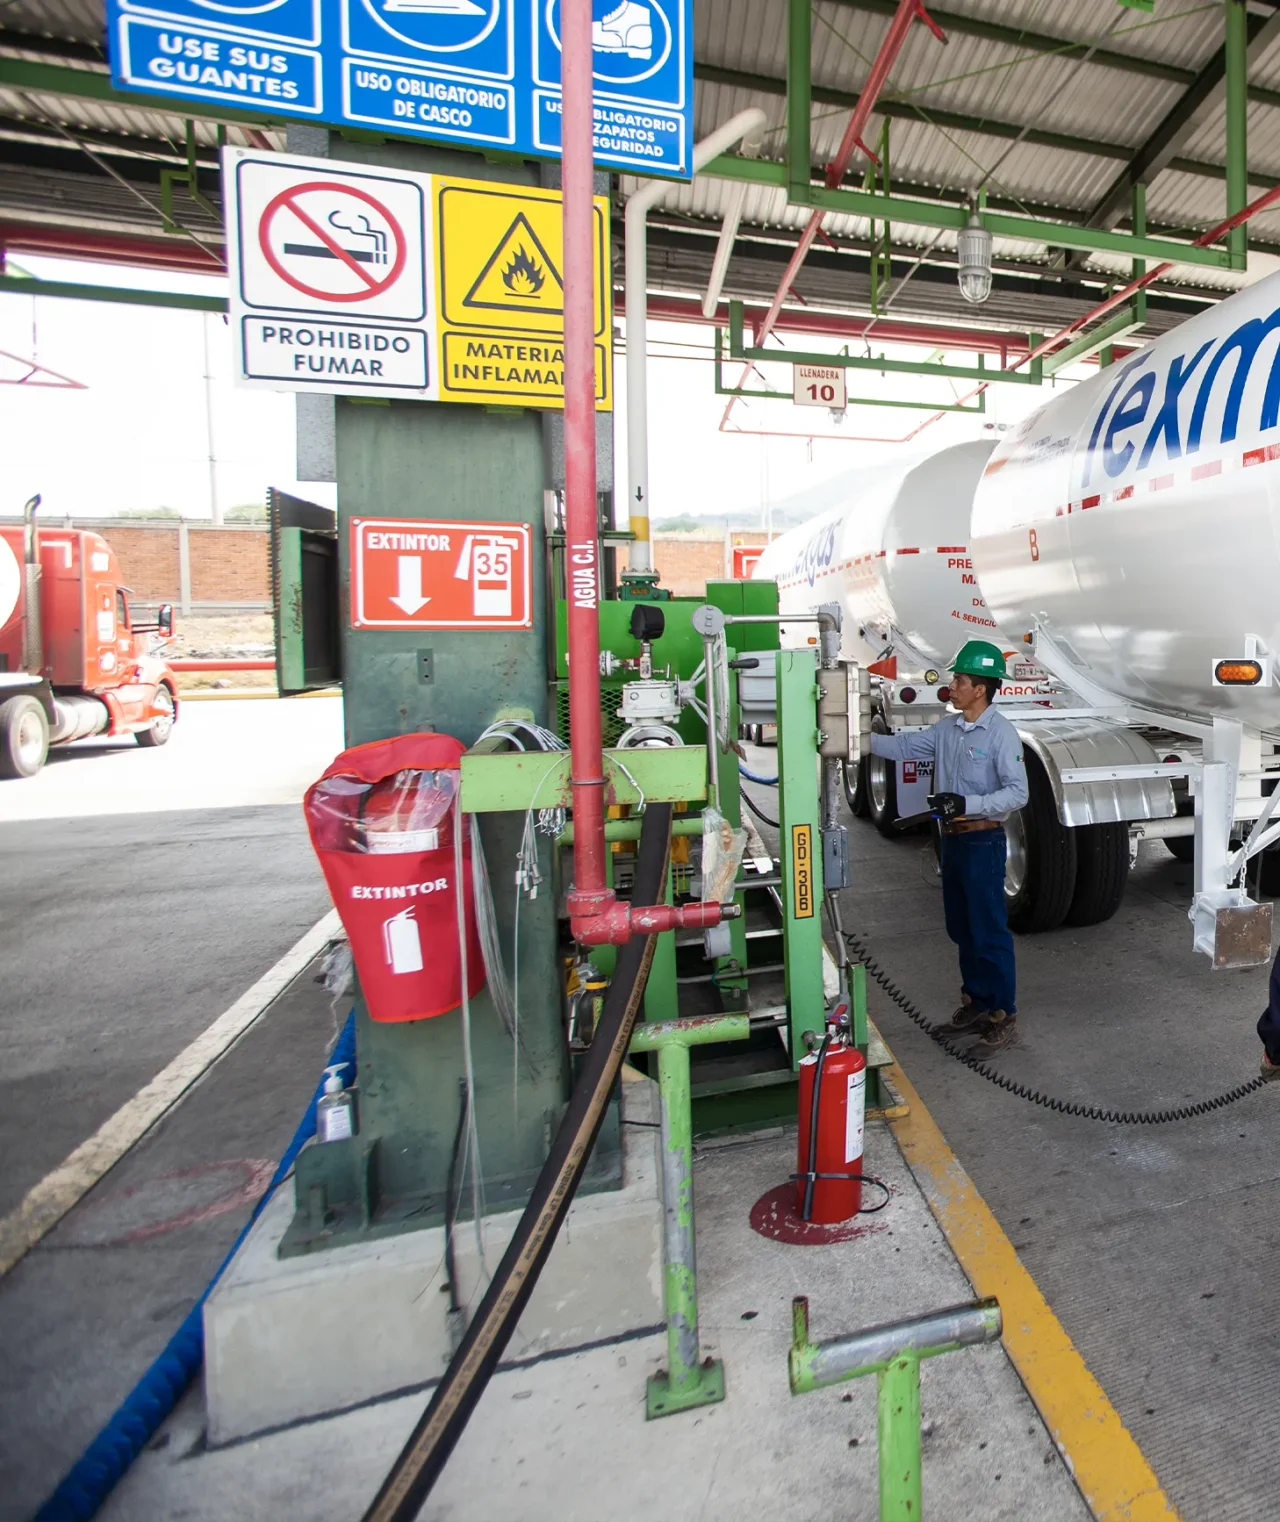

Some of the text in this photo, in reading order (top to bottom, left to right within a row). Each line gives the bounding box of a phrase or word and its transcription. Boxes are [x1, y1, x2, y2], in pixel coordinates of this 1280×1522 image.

[158, 33, 288, 73] USE SUS
[148, 57, 299, 99] GUANTES
[355, 70, 506, 110] USO OBLIGATORIO
[393, 99, 472, 127] DE CASCO
[545, 101, 677, 132] US BLIGATORIO
[593, 123, 655, 143] ZAPATOS
[593, 137, 664, 157] EGURIDAD
[262, 326, 411, 353] PROHIBIDO
[466, 342, 564, 363] MATERIA
[294, 354, 385, 376] FUMAR
[454, 364, 597, 388] INFLAMA
[800, 368, 839, 380] LLENADERA
[807, 384, 835, 401] 10
[367, 532, 451, 551] EXTINTOR
[477, 552, 508, 575] 35
[572, 540, 596, 609] AGUA C.I.
[951, 610, 961, 618] AL
[351, 878, 448, 899] EXTINTOR
[538, 1211, 552, 1232] Gas
[524, 1233, 541, 1260] Hose
